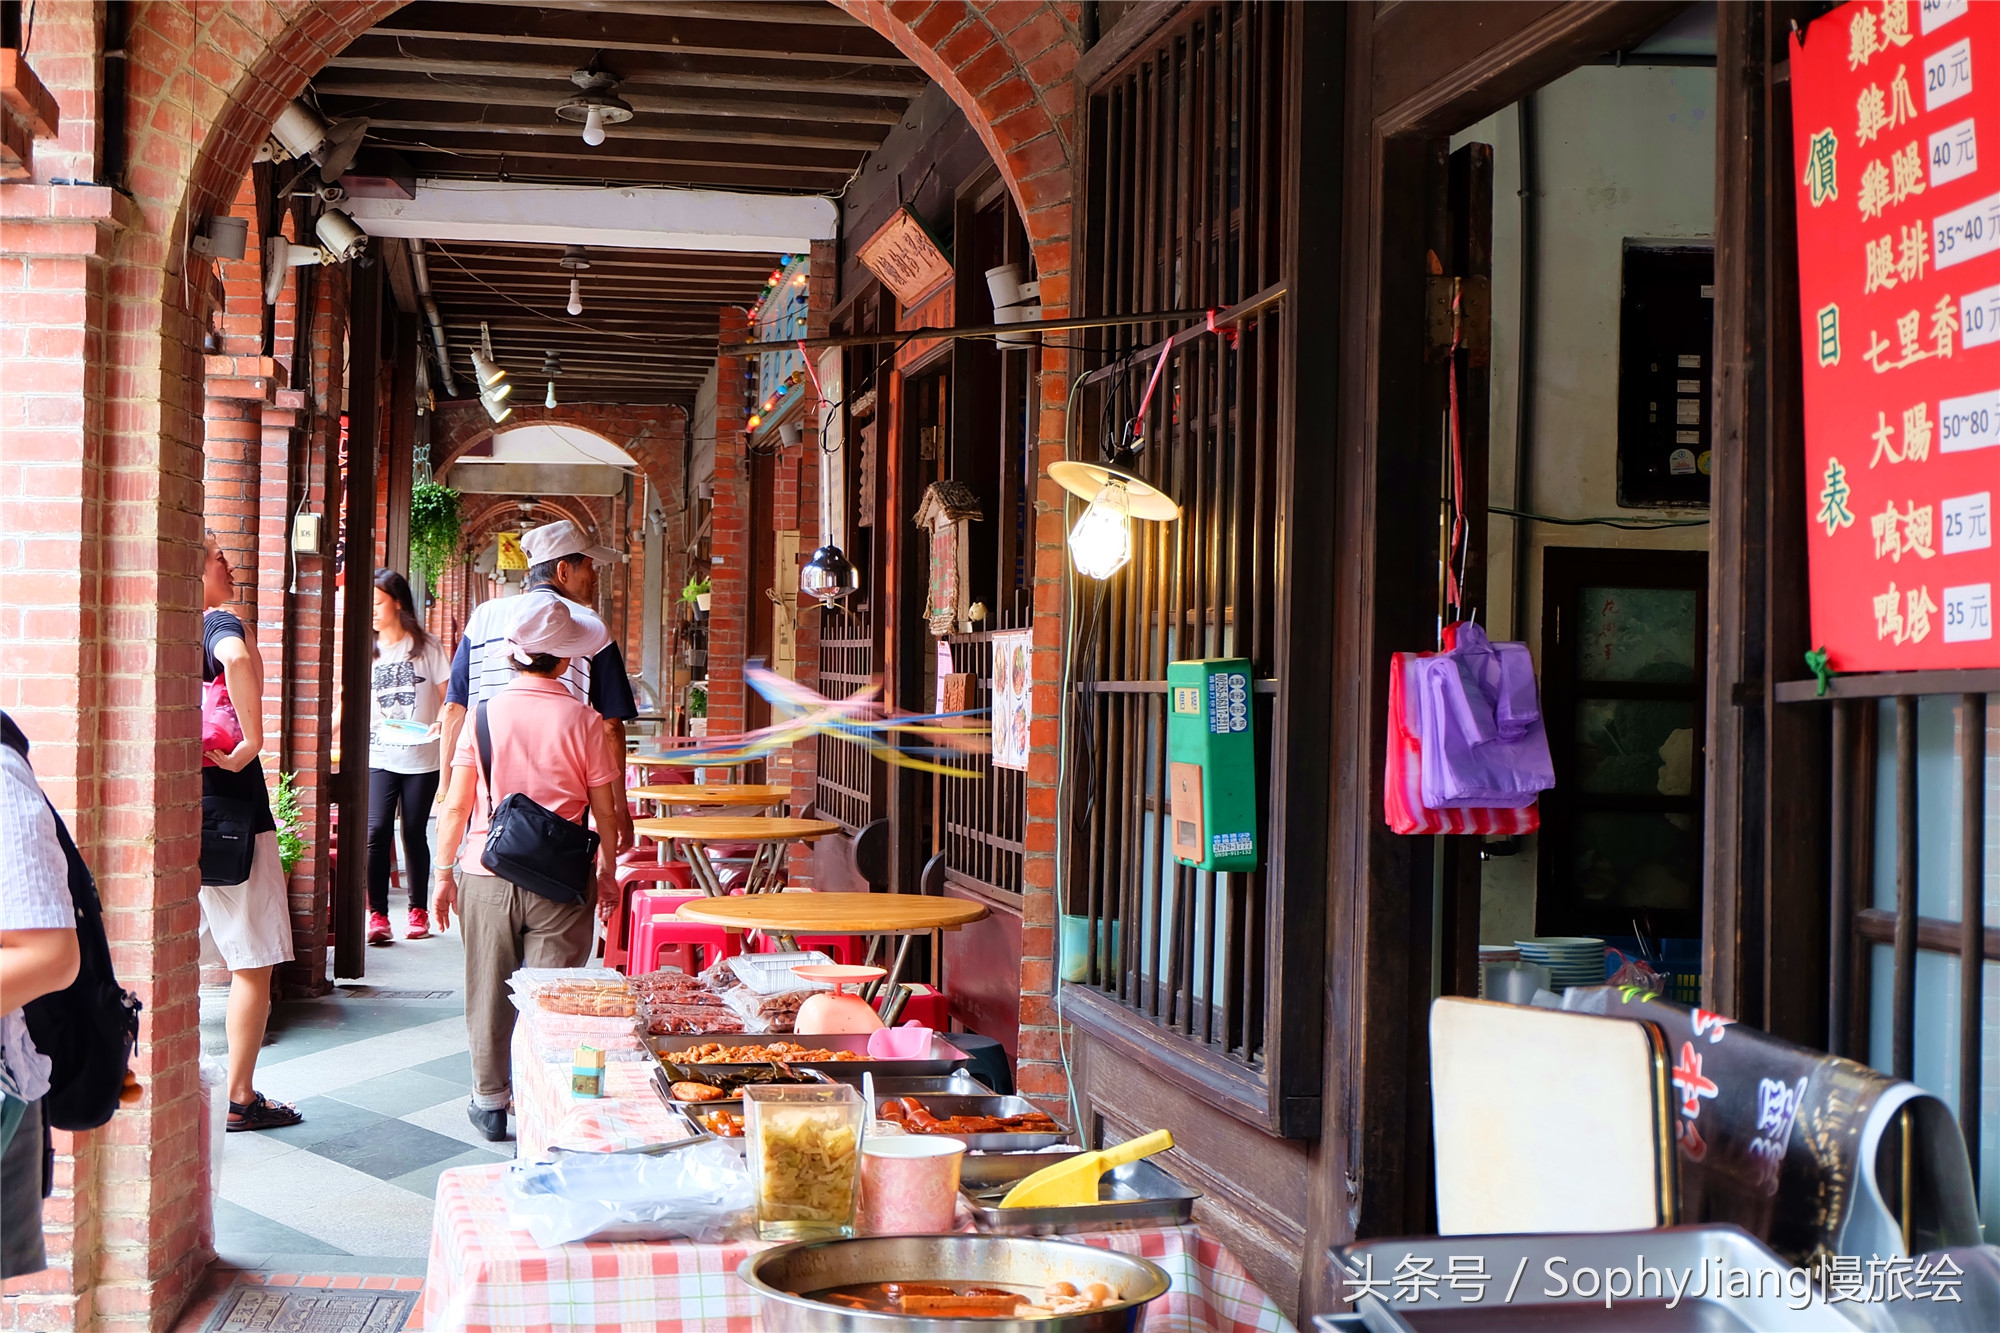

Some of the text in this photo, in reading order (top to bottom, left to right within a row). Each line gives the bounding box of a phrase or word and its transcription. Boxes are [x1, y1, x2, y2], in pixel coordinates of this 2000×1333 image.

[1856, 64, 1918, 148] 雞爪
[1858, 140, 1927, 222] 雞腿
[1864, 219, 1930, 295] 腿排
[1863, 294, 1959, 374] 七里香
[1869, 402, 1934, 470] 大腸
[1870, 499, 1937, 564] 鴨翅
[1872, 580, 1939, 647] 鴨胗
